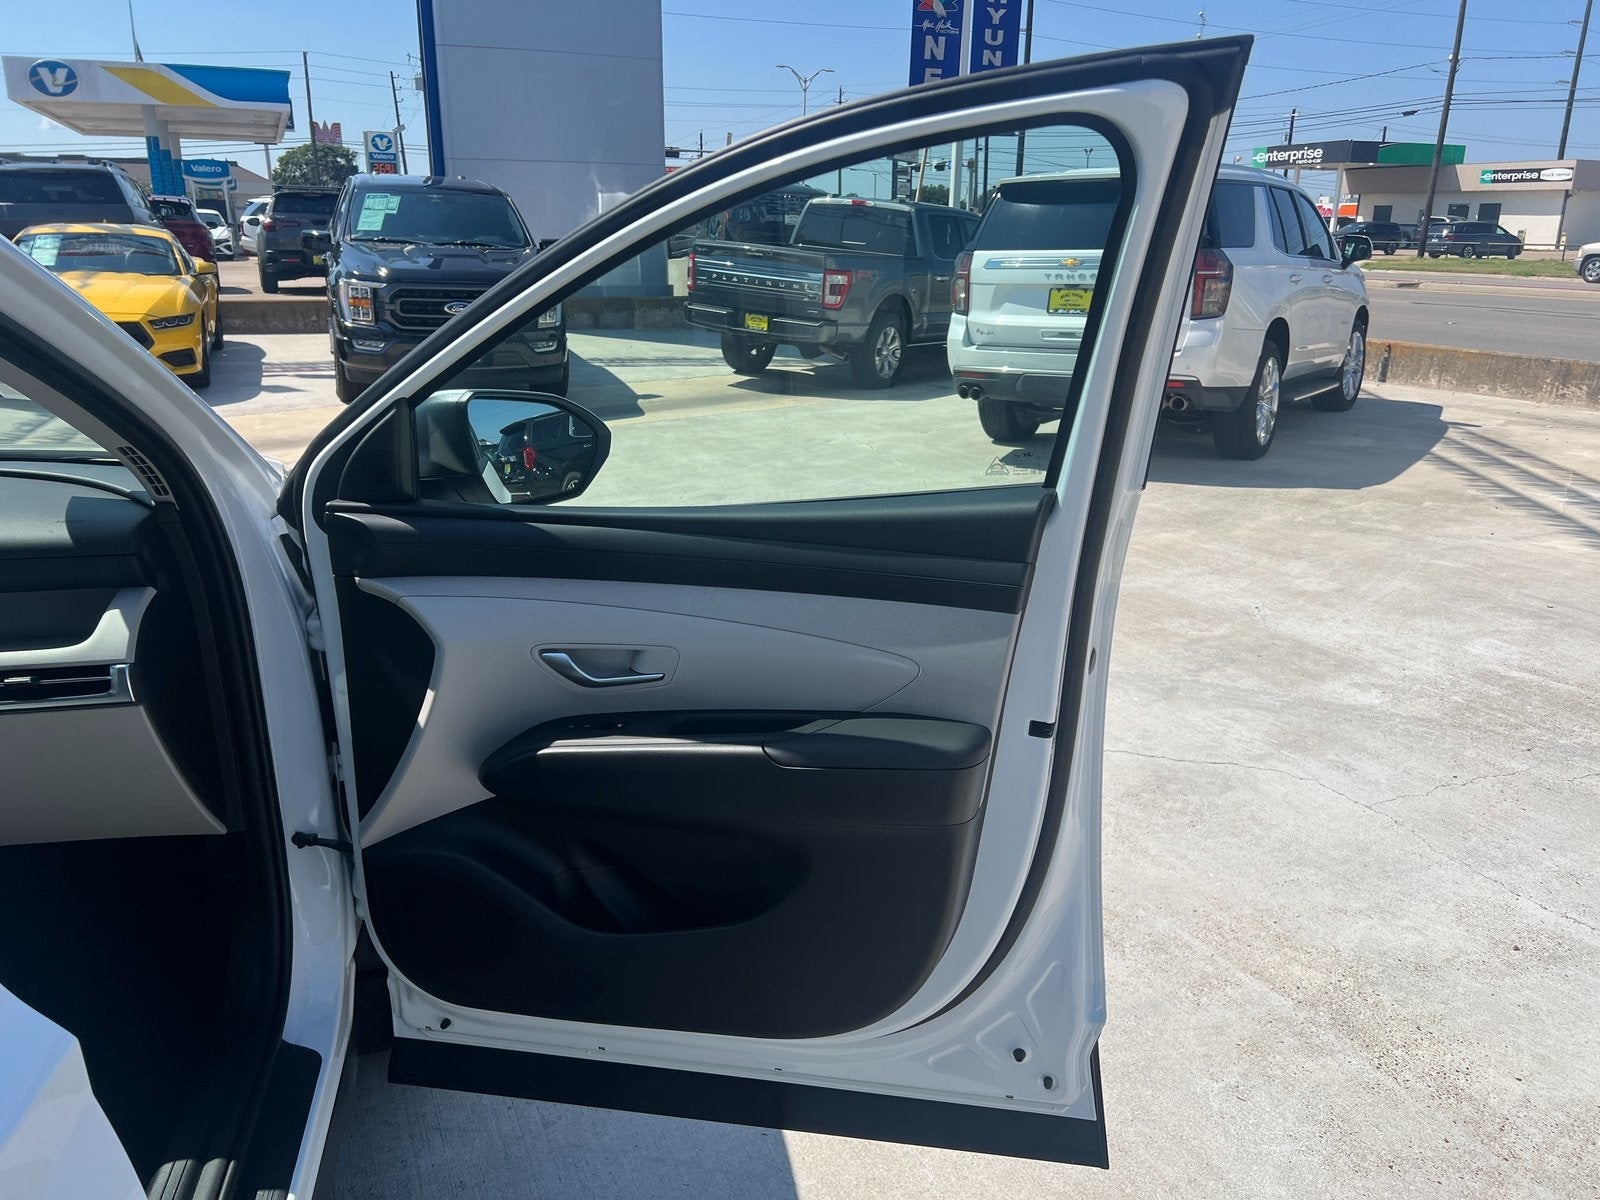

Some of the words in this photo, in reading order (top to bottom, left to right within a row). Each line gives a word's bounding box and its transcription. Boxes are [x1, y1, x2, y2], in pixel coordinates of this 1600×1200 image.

[1252, 147, 1323, 163] enterprise
[191, 164, 222, 173] Valero
[1480, 171, 1539, 181] enterprise
[712, 273, 800, 289] PLATINUM
